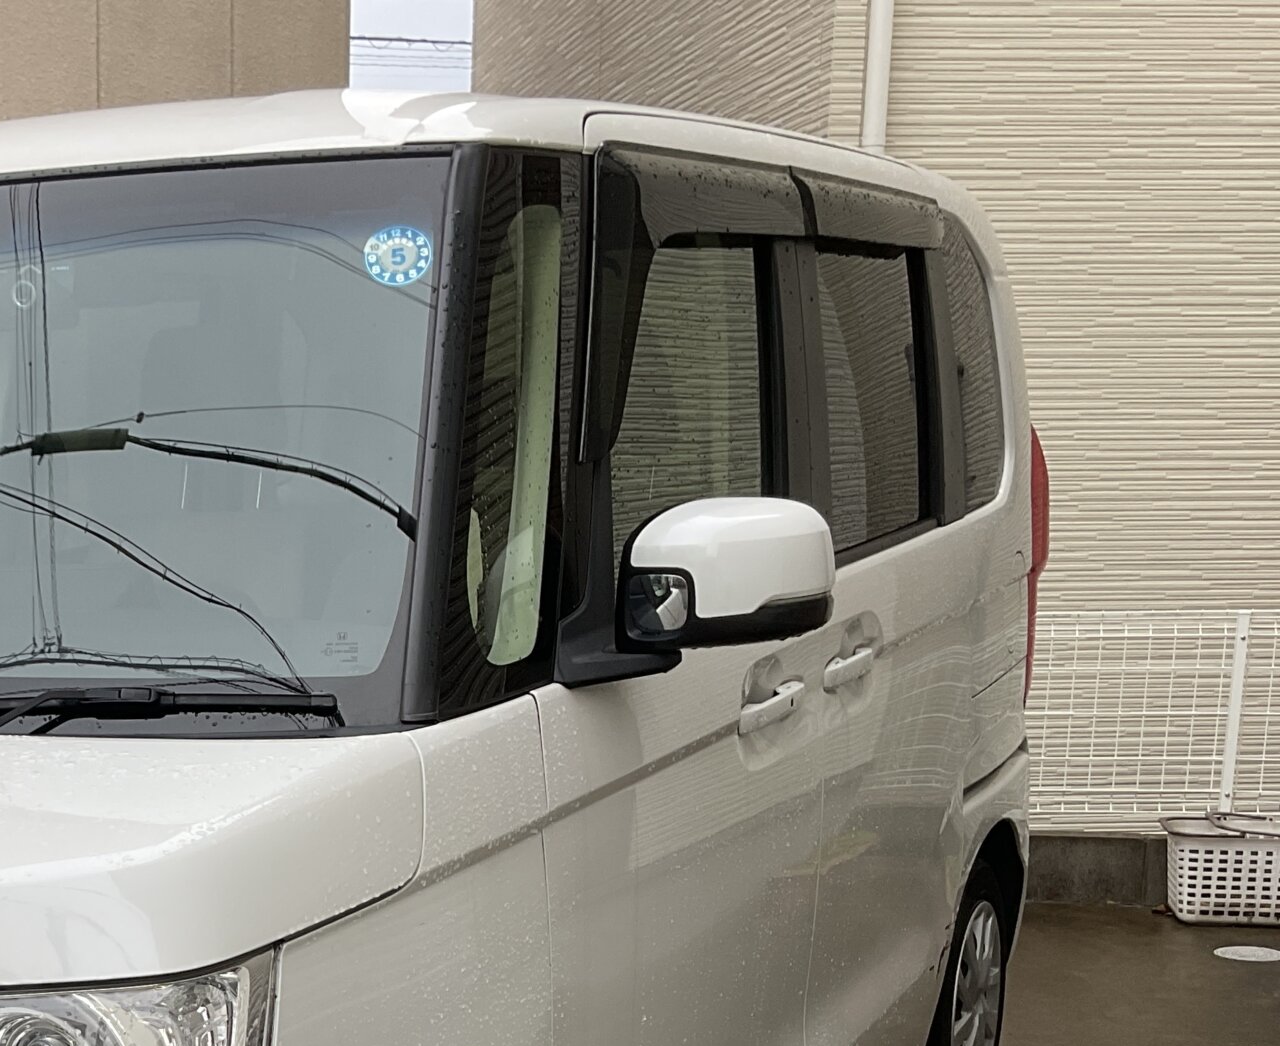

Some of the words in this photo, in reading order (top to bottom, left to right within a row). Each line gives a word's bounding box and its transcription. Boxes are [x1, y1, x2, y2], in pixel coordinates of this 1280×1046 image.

[406, 230, 412, 238] 1
[416, 236, 425, 245] 2
[391, 247, 406, 265] 5
[420, 247, 428, 256] 3
[368, 254, 377, 263] 9
[417, 259, 426, 268] 4
[382, 272, 390, 281] 7
[396, 273, 404, 283] 6
